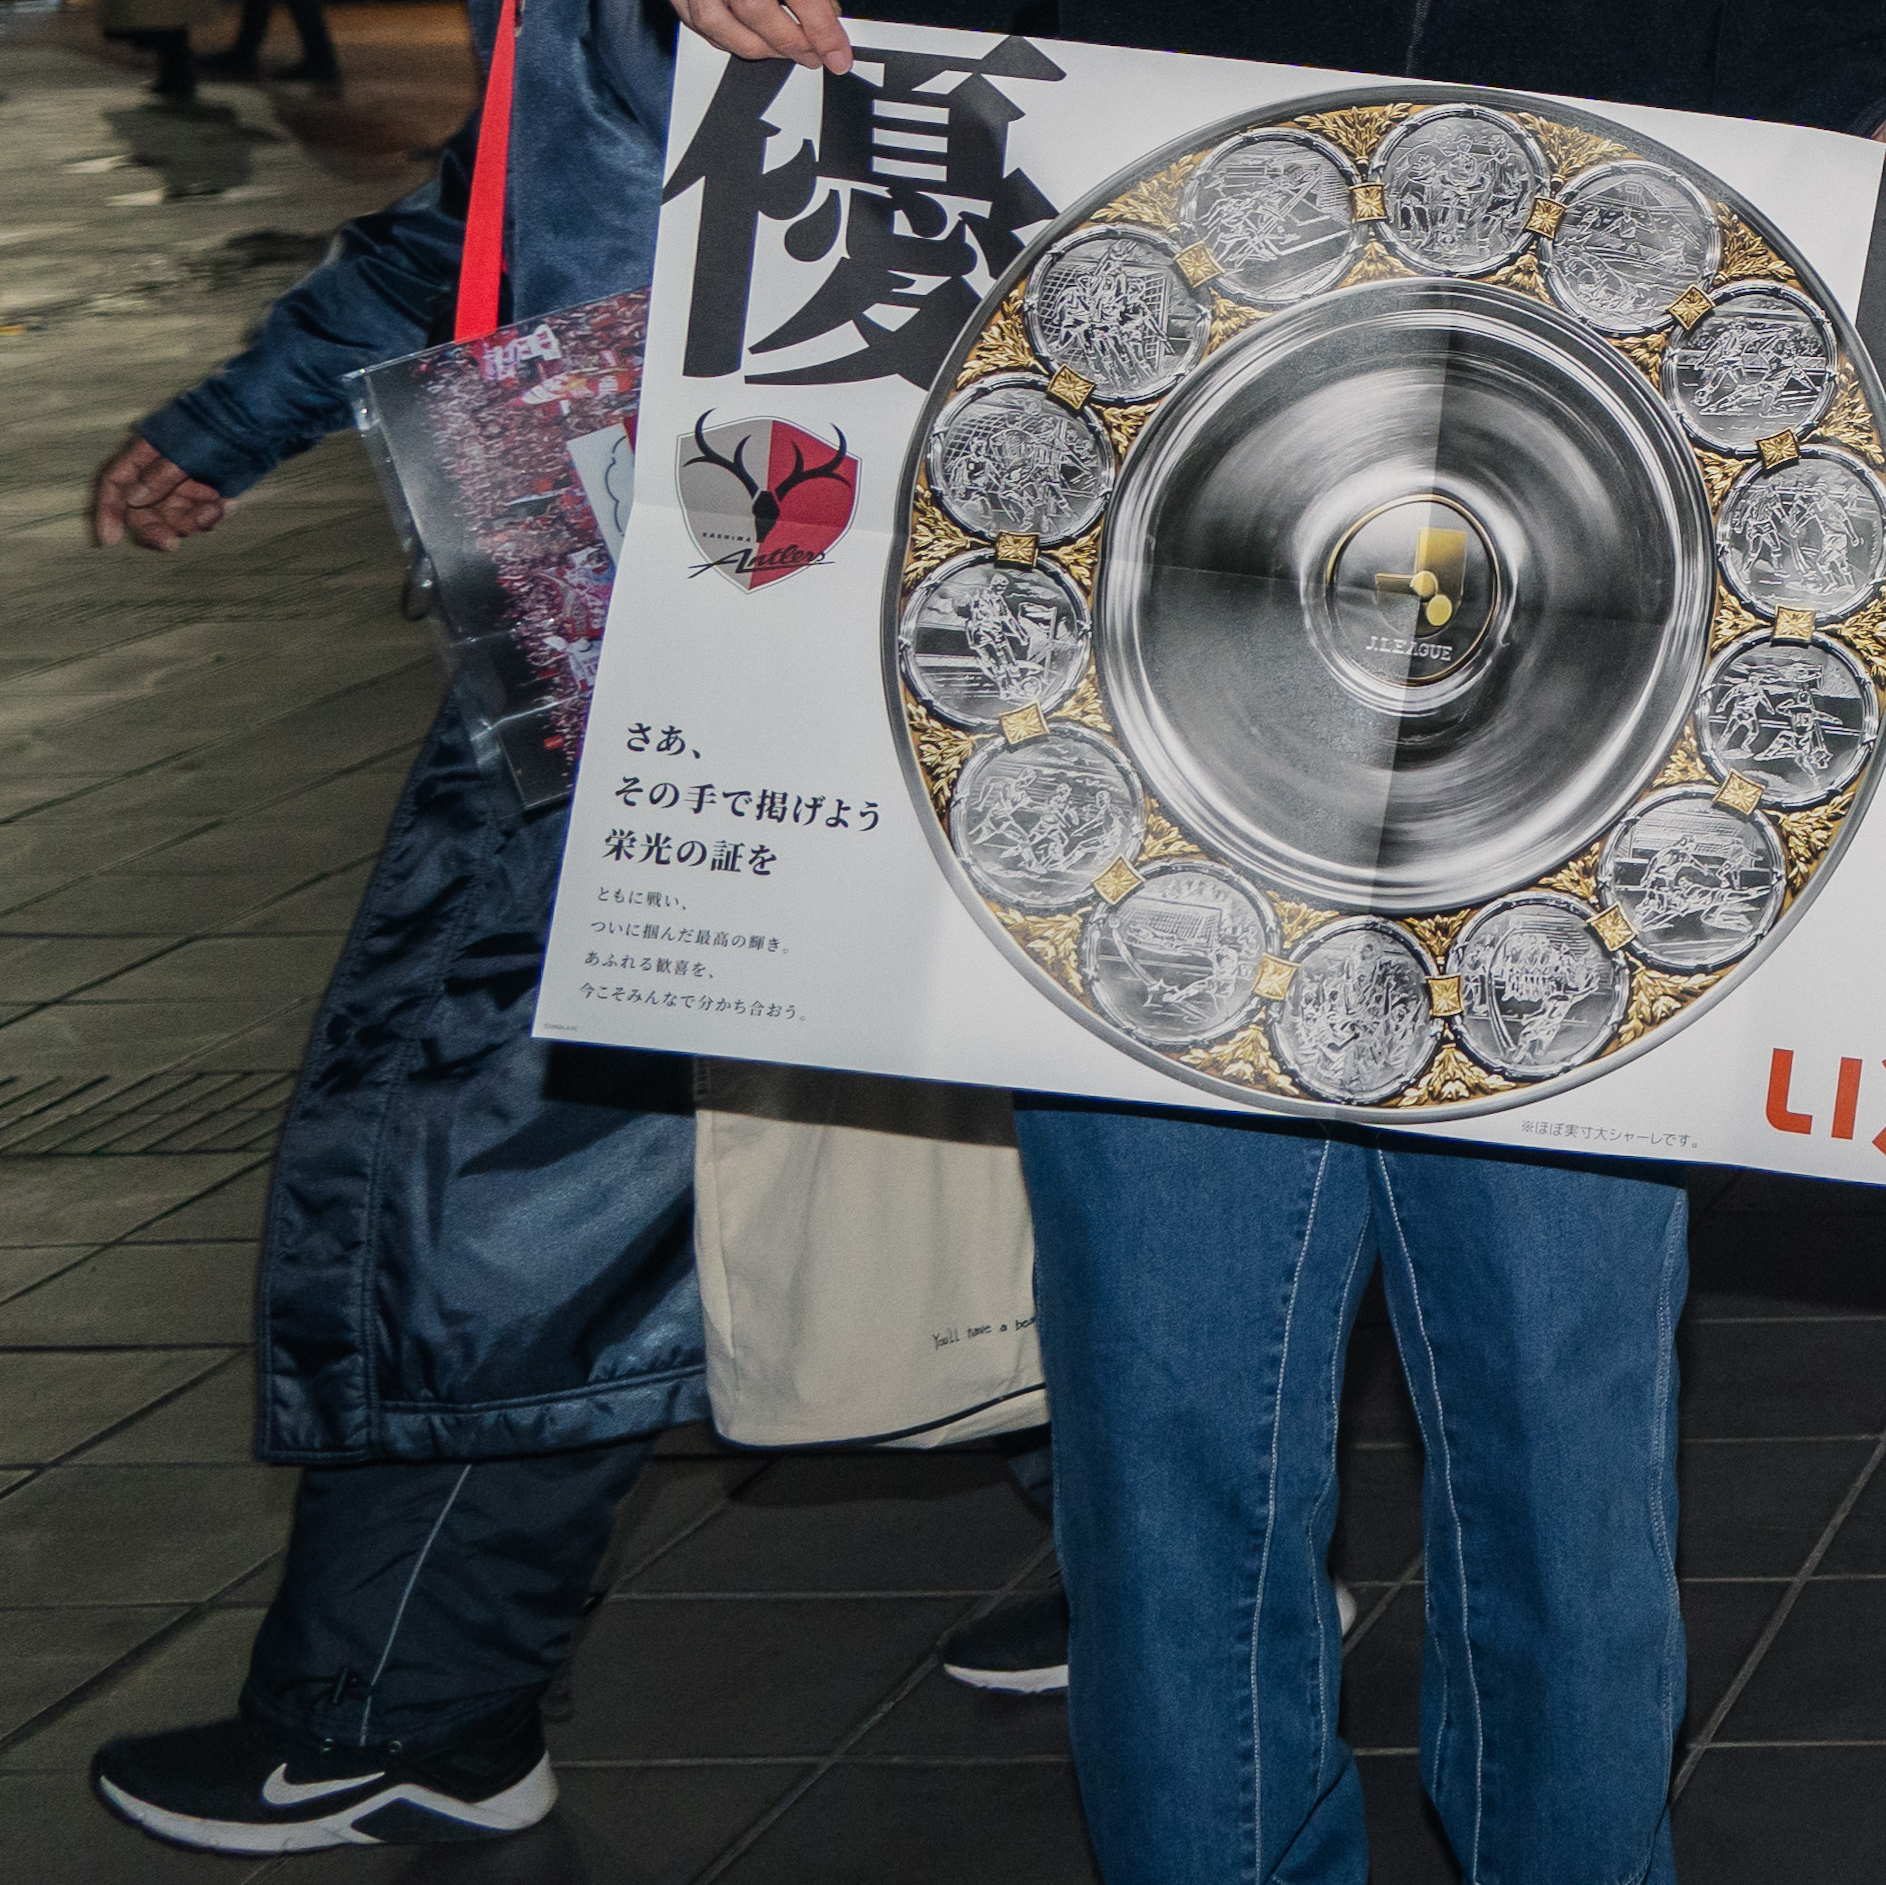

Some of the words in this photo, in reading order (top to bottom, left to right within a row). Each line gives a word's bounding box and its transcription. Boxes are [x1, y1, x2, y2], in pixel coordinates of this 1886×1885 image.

[662, 36, 1066, 391] 優
[687, 543, 836, 580] Antlers
[1365, 634, 1454, 663] J.LEAGUE
[626, 721, 701, 760] さあ、
[614, 775, 881, 832] その手で掲げよう
[602, 827, 778, 877] 栄光の証を
[597, 885, 688, 911] ともに戦い、
[583, 950, 715, 980] あふれる歓喜を、
[578, 981, 808, 1023] 今こそみんなで分かち合おう。
[1521, 1118, 1698, 1150] ※ほぼ実寸大シャーレです。
[1000, 1323, 1008, 1332] a
